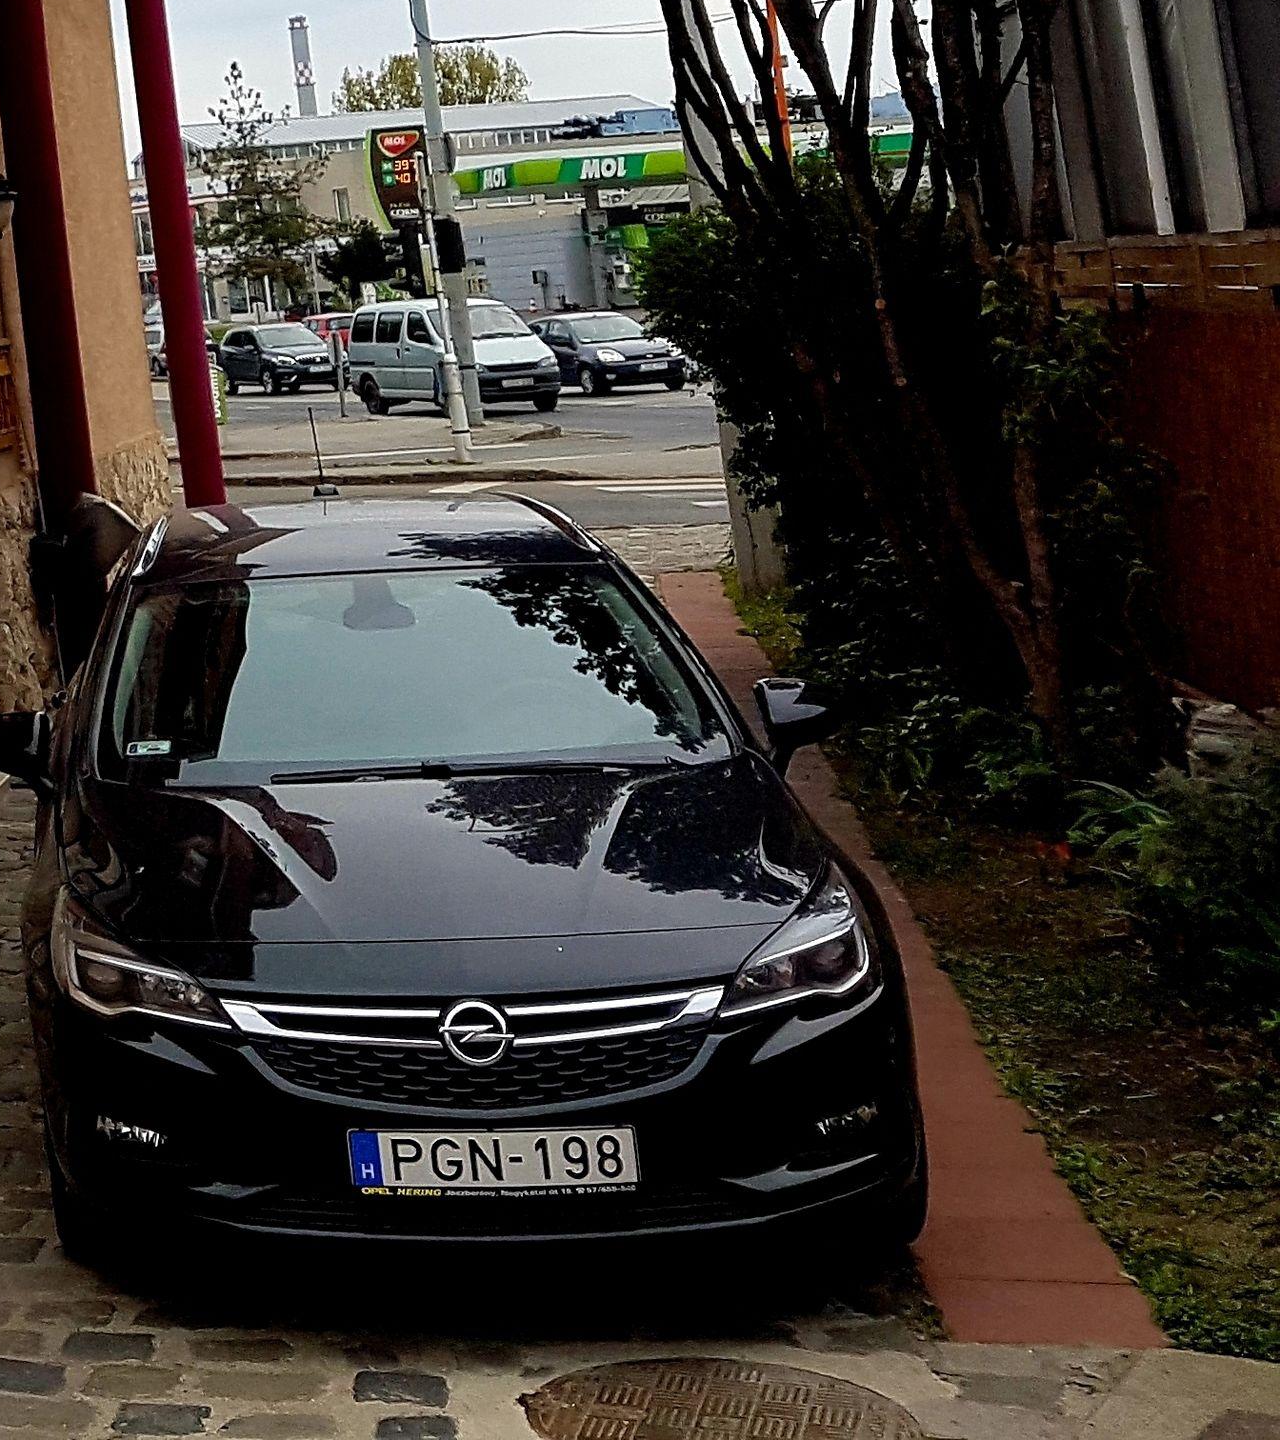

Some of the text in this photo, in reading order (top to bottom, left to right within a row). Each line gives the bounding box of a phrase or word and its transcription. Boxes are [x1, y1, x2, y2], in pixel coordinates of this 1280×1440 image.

[383, 135, 407, 148] MOL
[580, 157, 627, 180] MOL
[483, 167, 507, 190] MOL
[390, 1134, 624, 1182] PGN-198
[361, 1163, 375, 1179] H
[361, 1187, 394, 1196] OPEL
[396, 1188, 442, 1197] HERING
